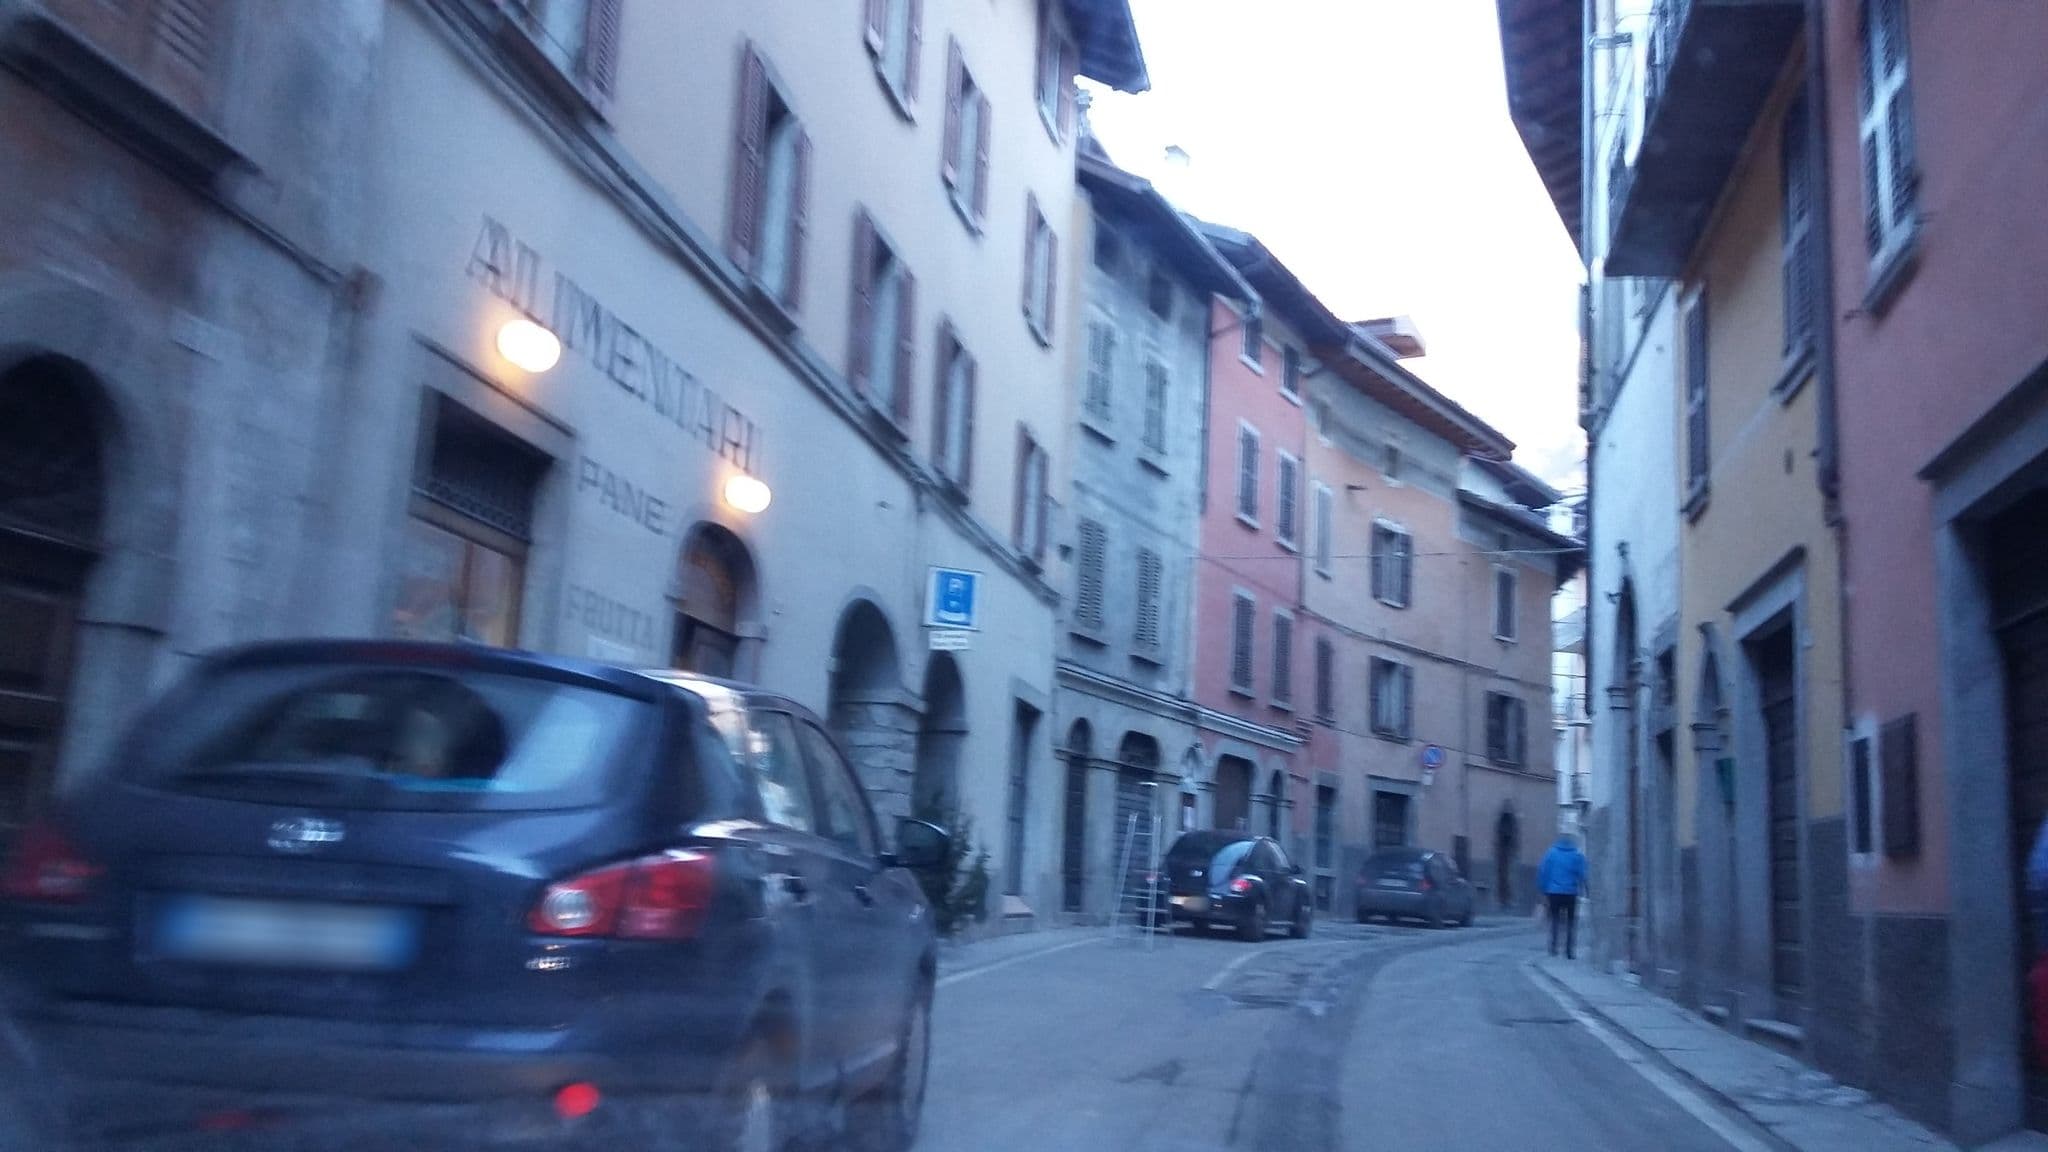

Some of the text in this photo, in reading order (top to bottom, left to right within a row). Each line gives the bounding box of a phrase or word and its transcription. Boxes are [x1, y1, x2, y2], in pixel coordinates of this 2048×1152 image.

[463, 212, 765, 475] ALIMENTARI
[577, 455, 669, 537] PANE
[566, 583, 661, 652] FRUTTA
